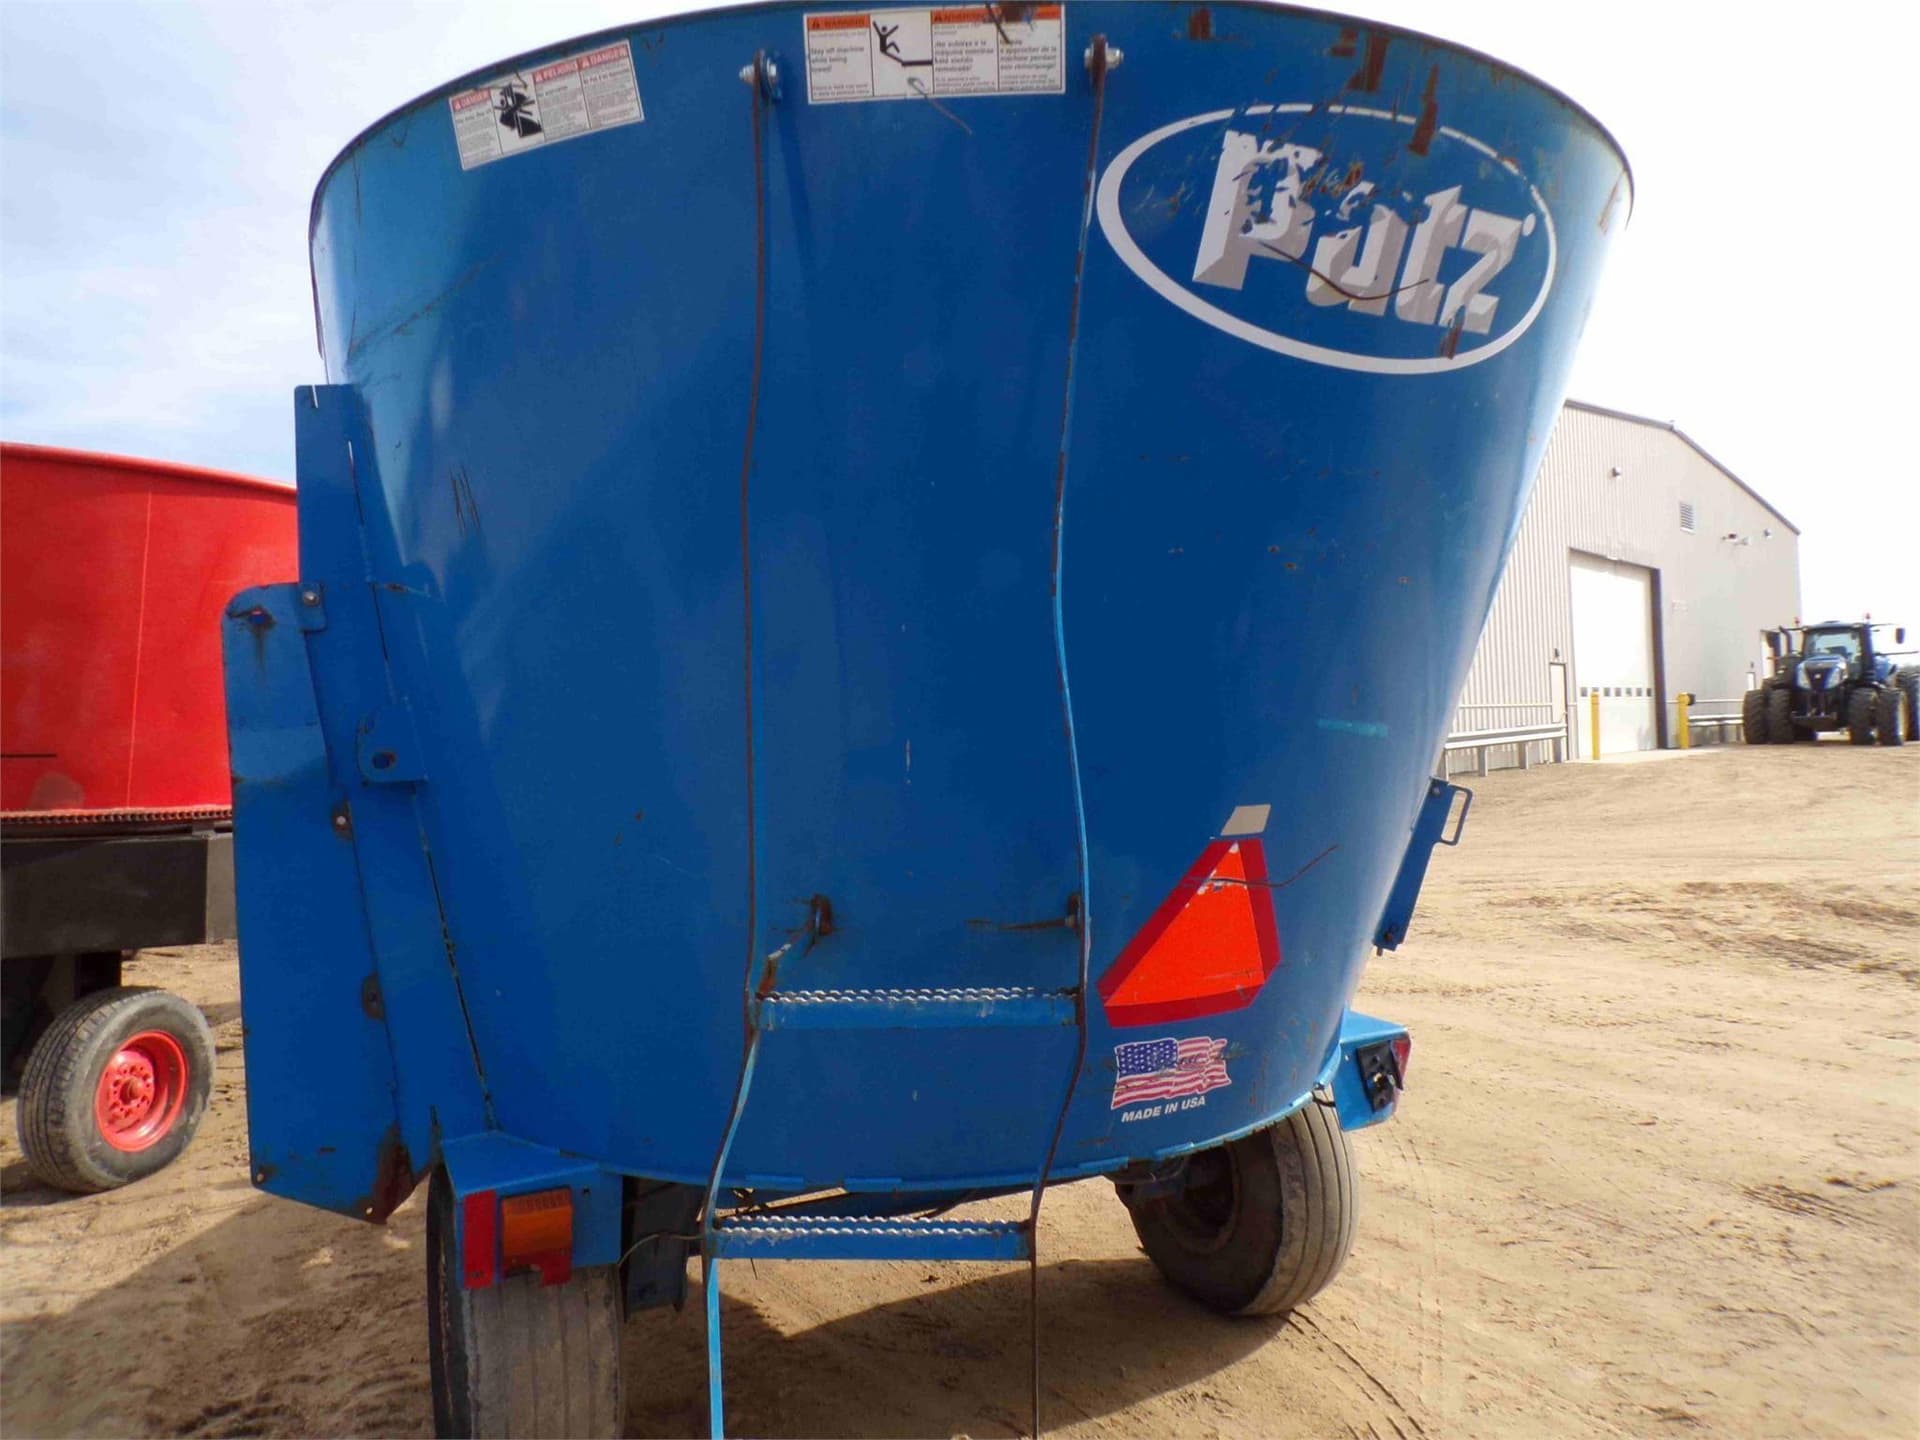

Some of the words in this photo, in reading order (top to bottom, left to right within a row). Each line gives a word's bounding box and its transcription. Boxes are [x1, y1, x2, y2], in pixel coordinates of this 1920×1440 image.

[1192, 129, 1524, 335] Patz
[1121, 1105, 1162, 1123] MADE
[1164, 1102, 1178, 1114] IN
[1181, 1095, 1206, 1110] USA
